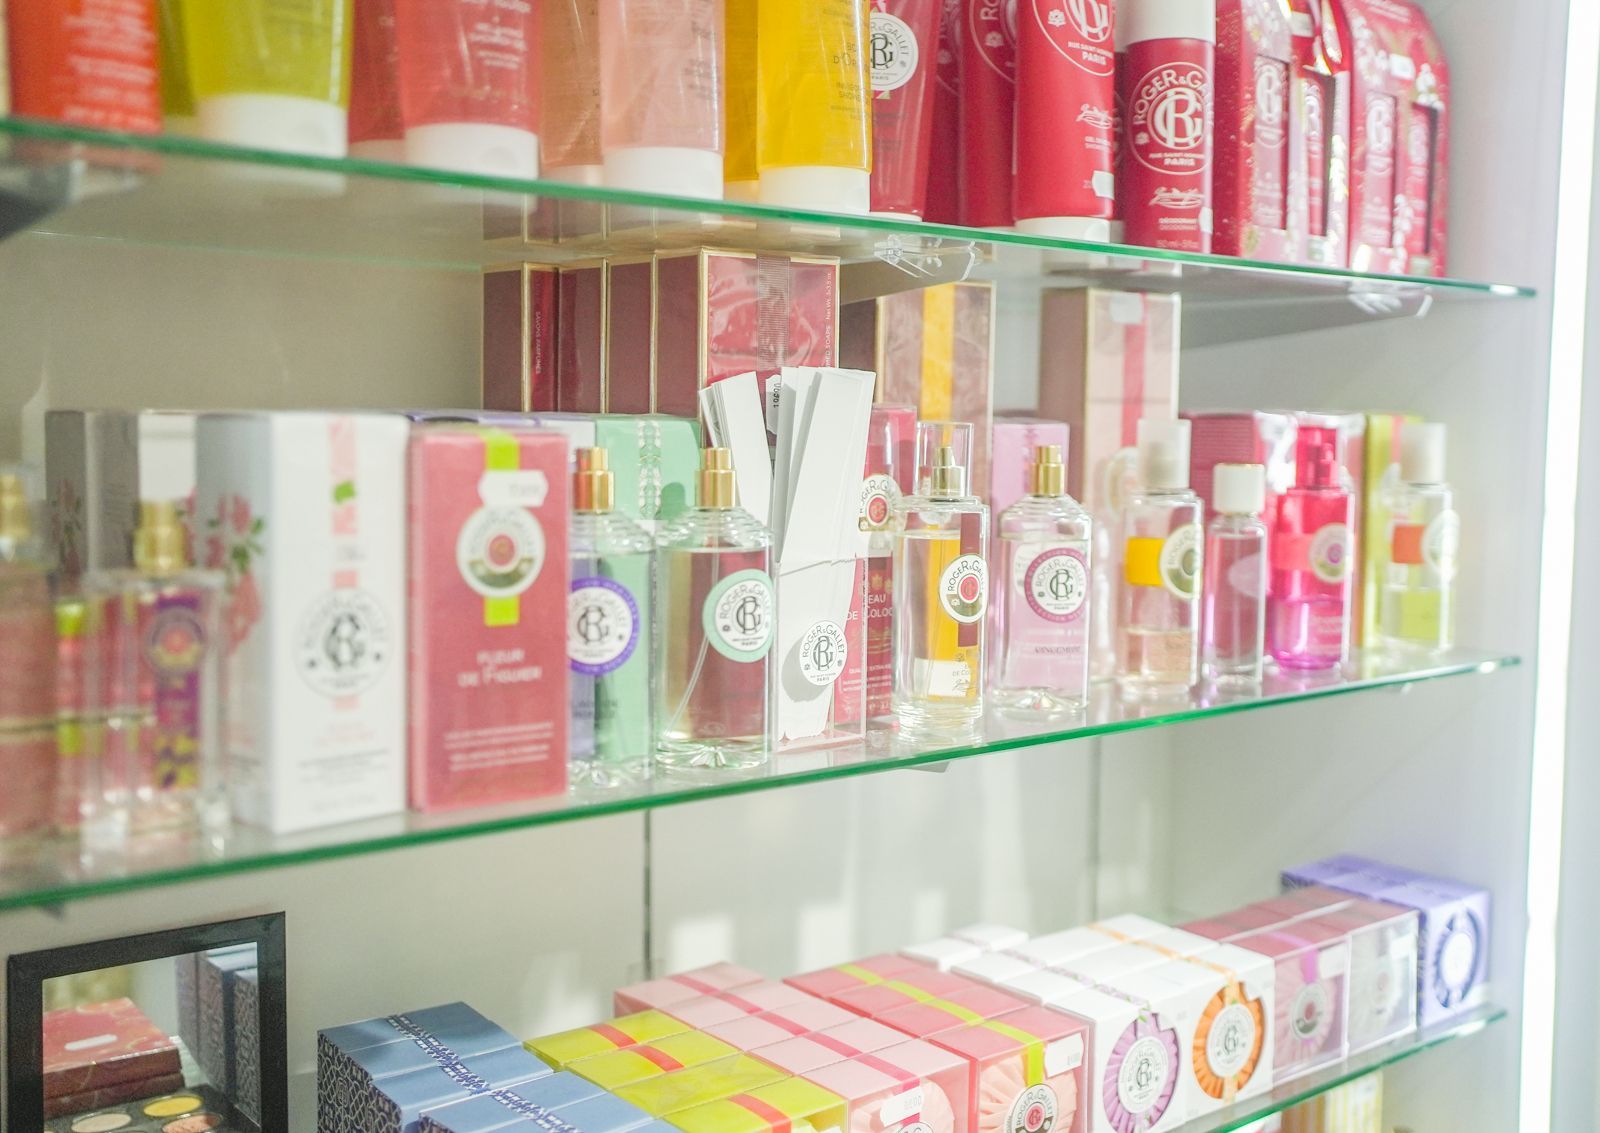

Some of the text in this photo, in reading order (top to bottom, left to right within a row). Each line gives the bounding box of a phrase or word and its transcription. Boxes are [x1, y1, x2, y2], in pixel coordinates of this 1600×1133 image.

[1082, 51, 1107, 65] PARIS
[1163, 158, 1196, 166] PARIS
[868, 593, 887, 605] EAU
[846, 610, 859, 621] DE
